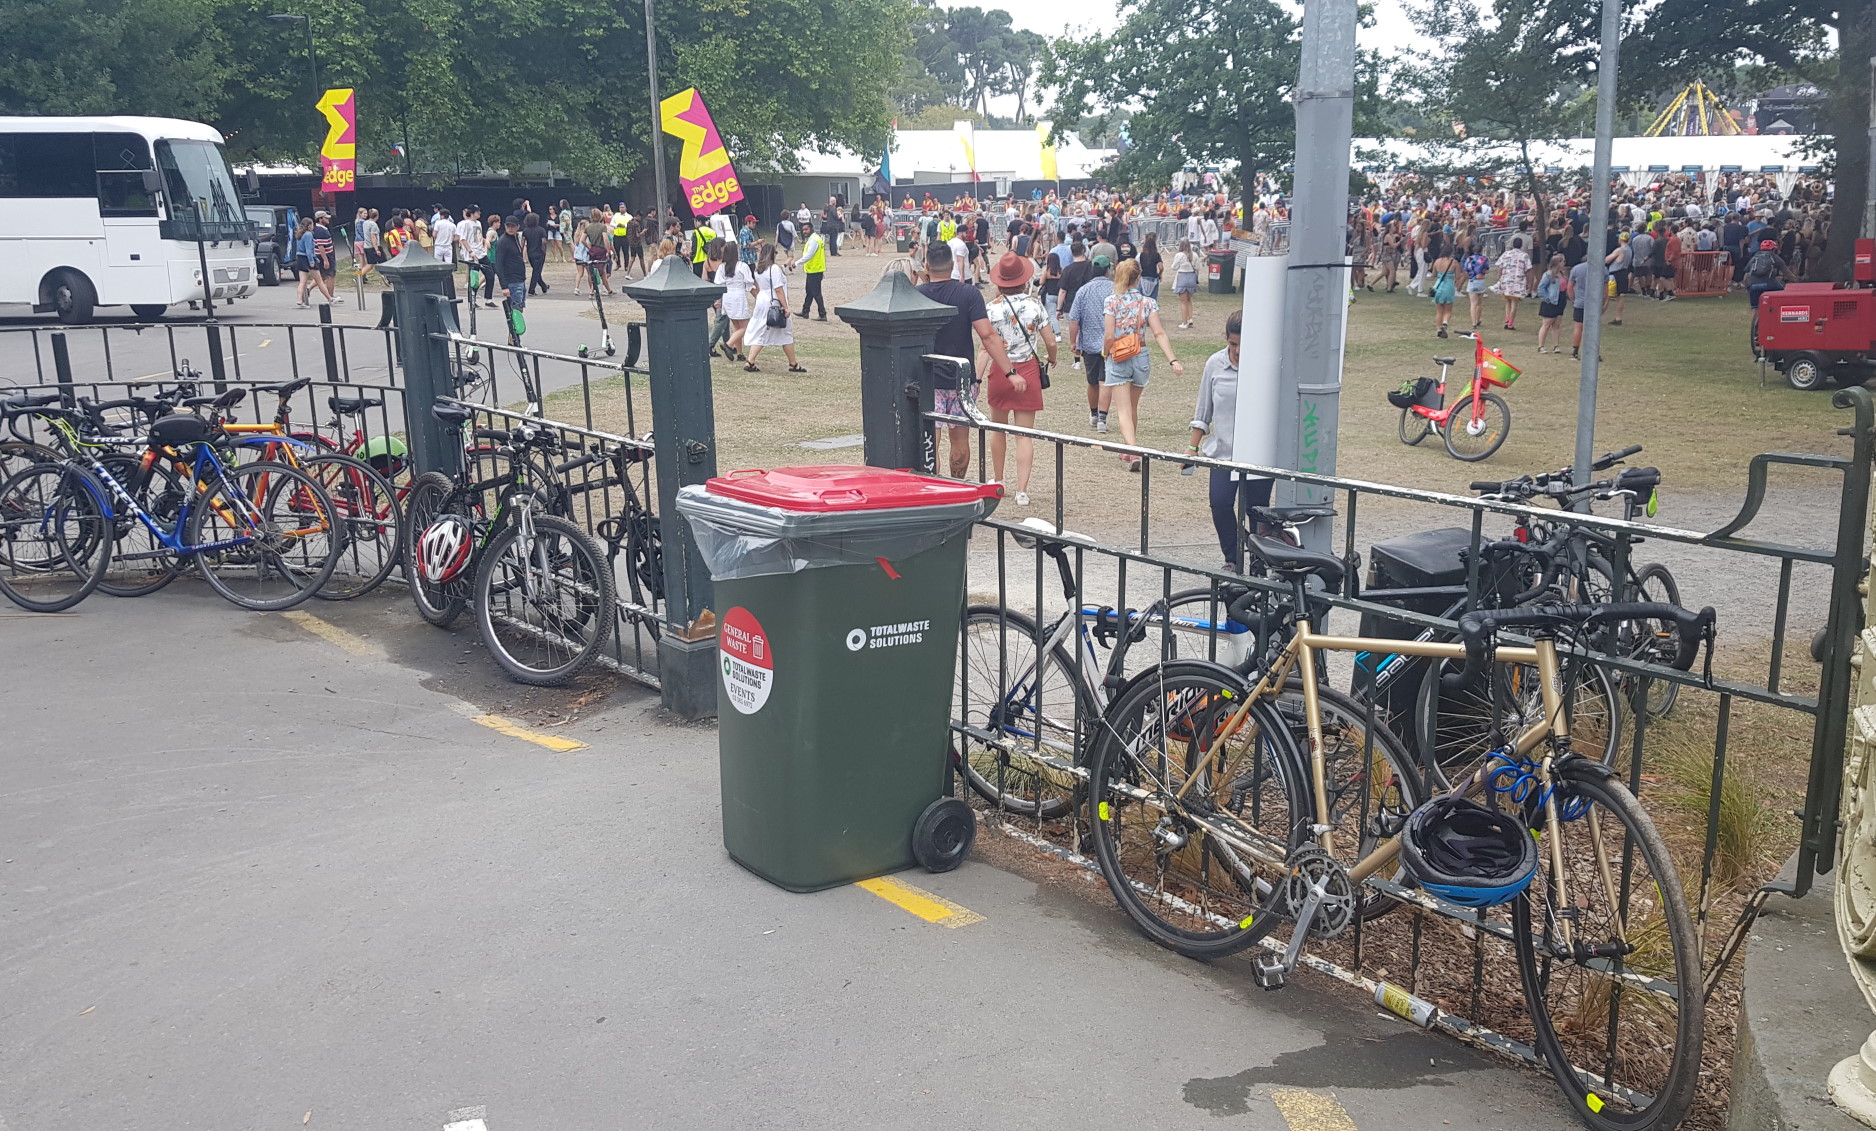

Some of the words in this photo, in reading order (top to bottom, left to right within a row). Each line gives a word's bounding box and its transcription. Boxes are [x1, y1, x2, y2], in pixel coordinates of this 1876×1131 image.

[690, 177, 739, 209] edge
[691, 184, 705, 193] The
[100, 466, 144, 516] TREK
[723, 623, 752, 643] GENERAL
[869, 632, 923, 649] SOLUTIONS
[726, 636, 748, 654] WASTE
[732, 670, 762, 690] SOLUTIONS
[730, 683, 756, 703] EVENTS
